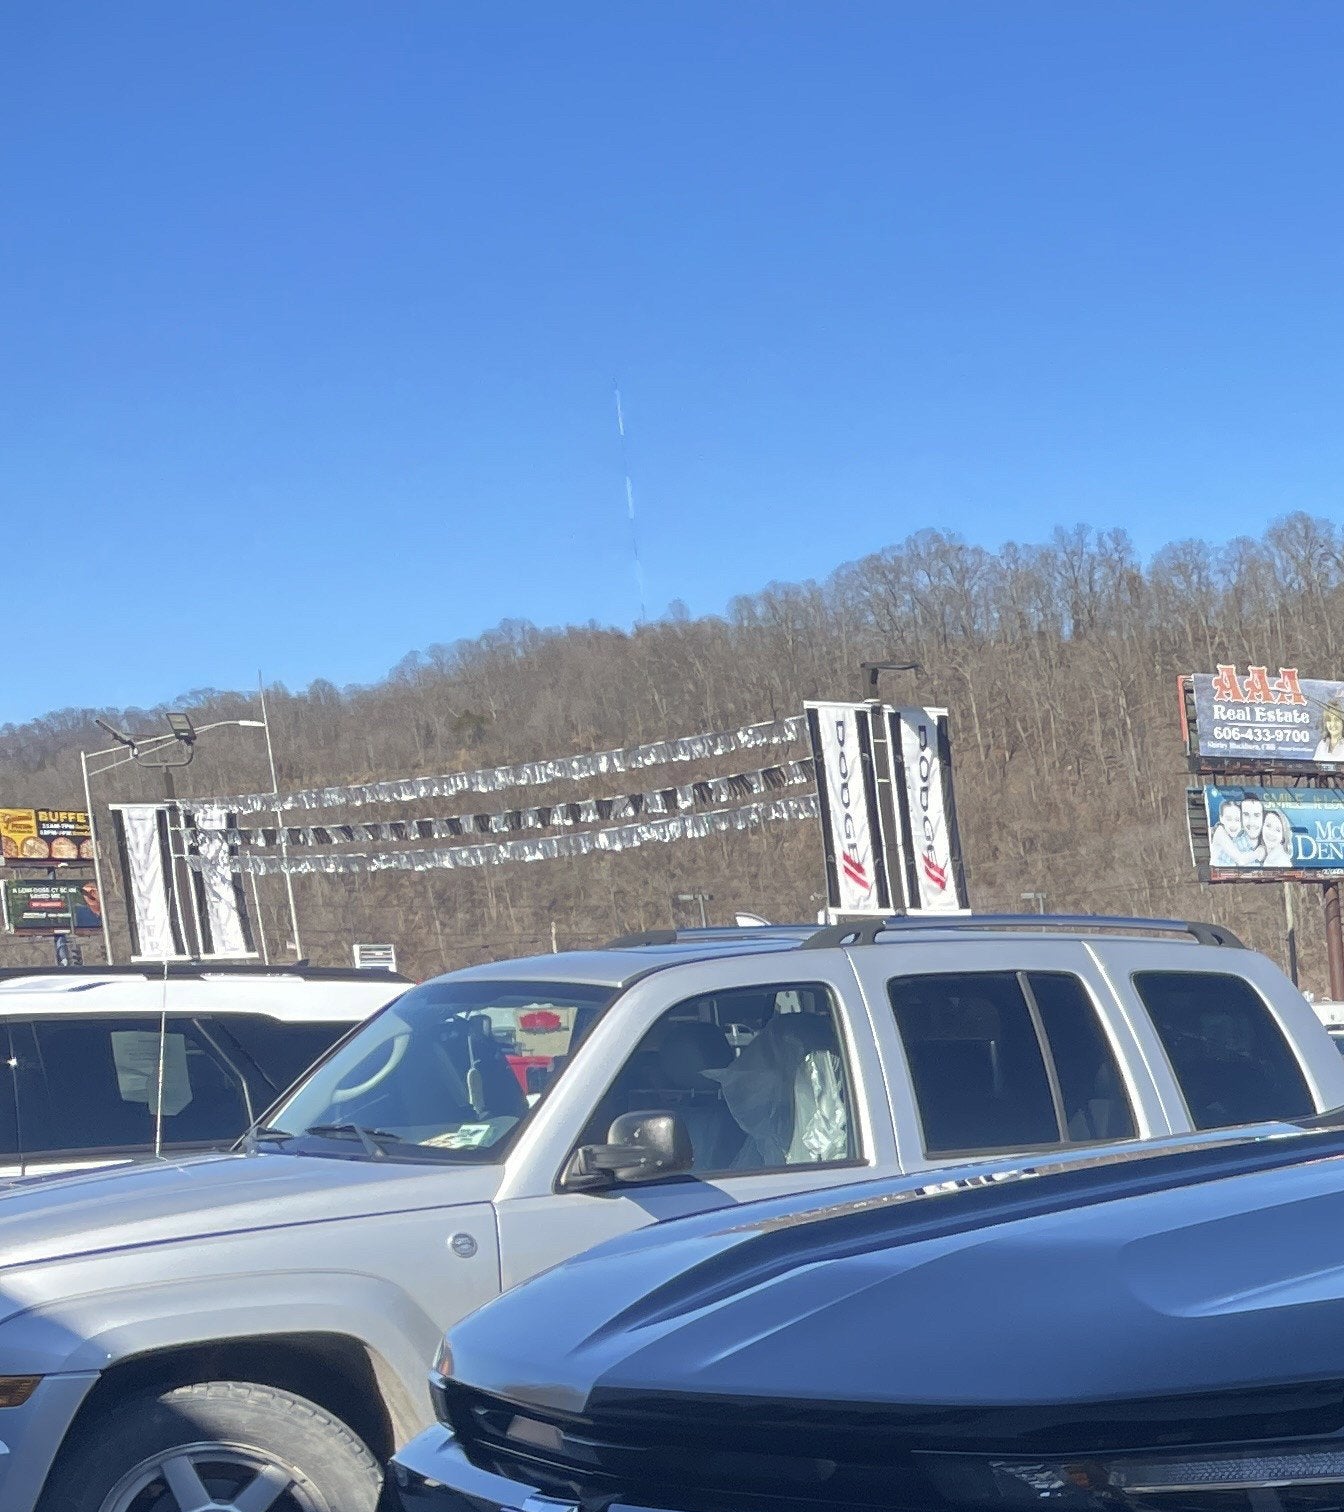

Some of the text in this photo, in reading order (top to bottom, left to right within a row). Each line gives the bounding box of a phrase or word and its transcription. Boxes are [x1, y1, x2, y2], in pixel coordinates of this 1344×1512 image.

[1212, 663, 1308, 706] AAA
[1213, 704, 1310, 723] Real Estate
[1213, 726, 1310, 743] 606-433-9700
[836, 721, 861, 865] DODGE
[918, 725, 939, 867] DODGE
